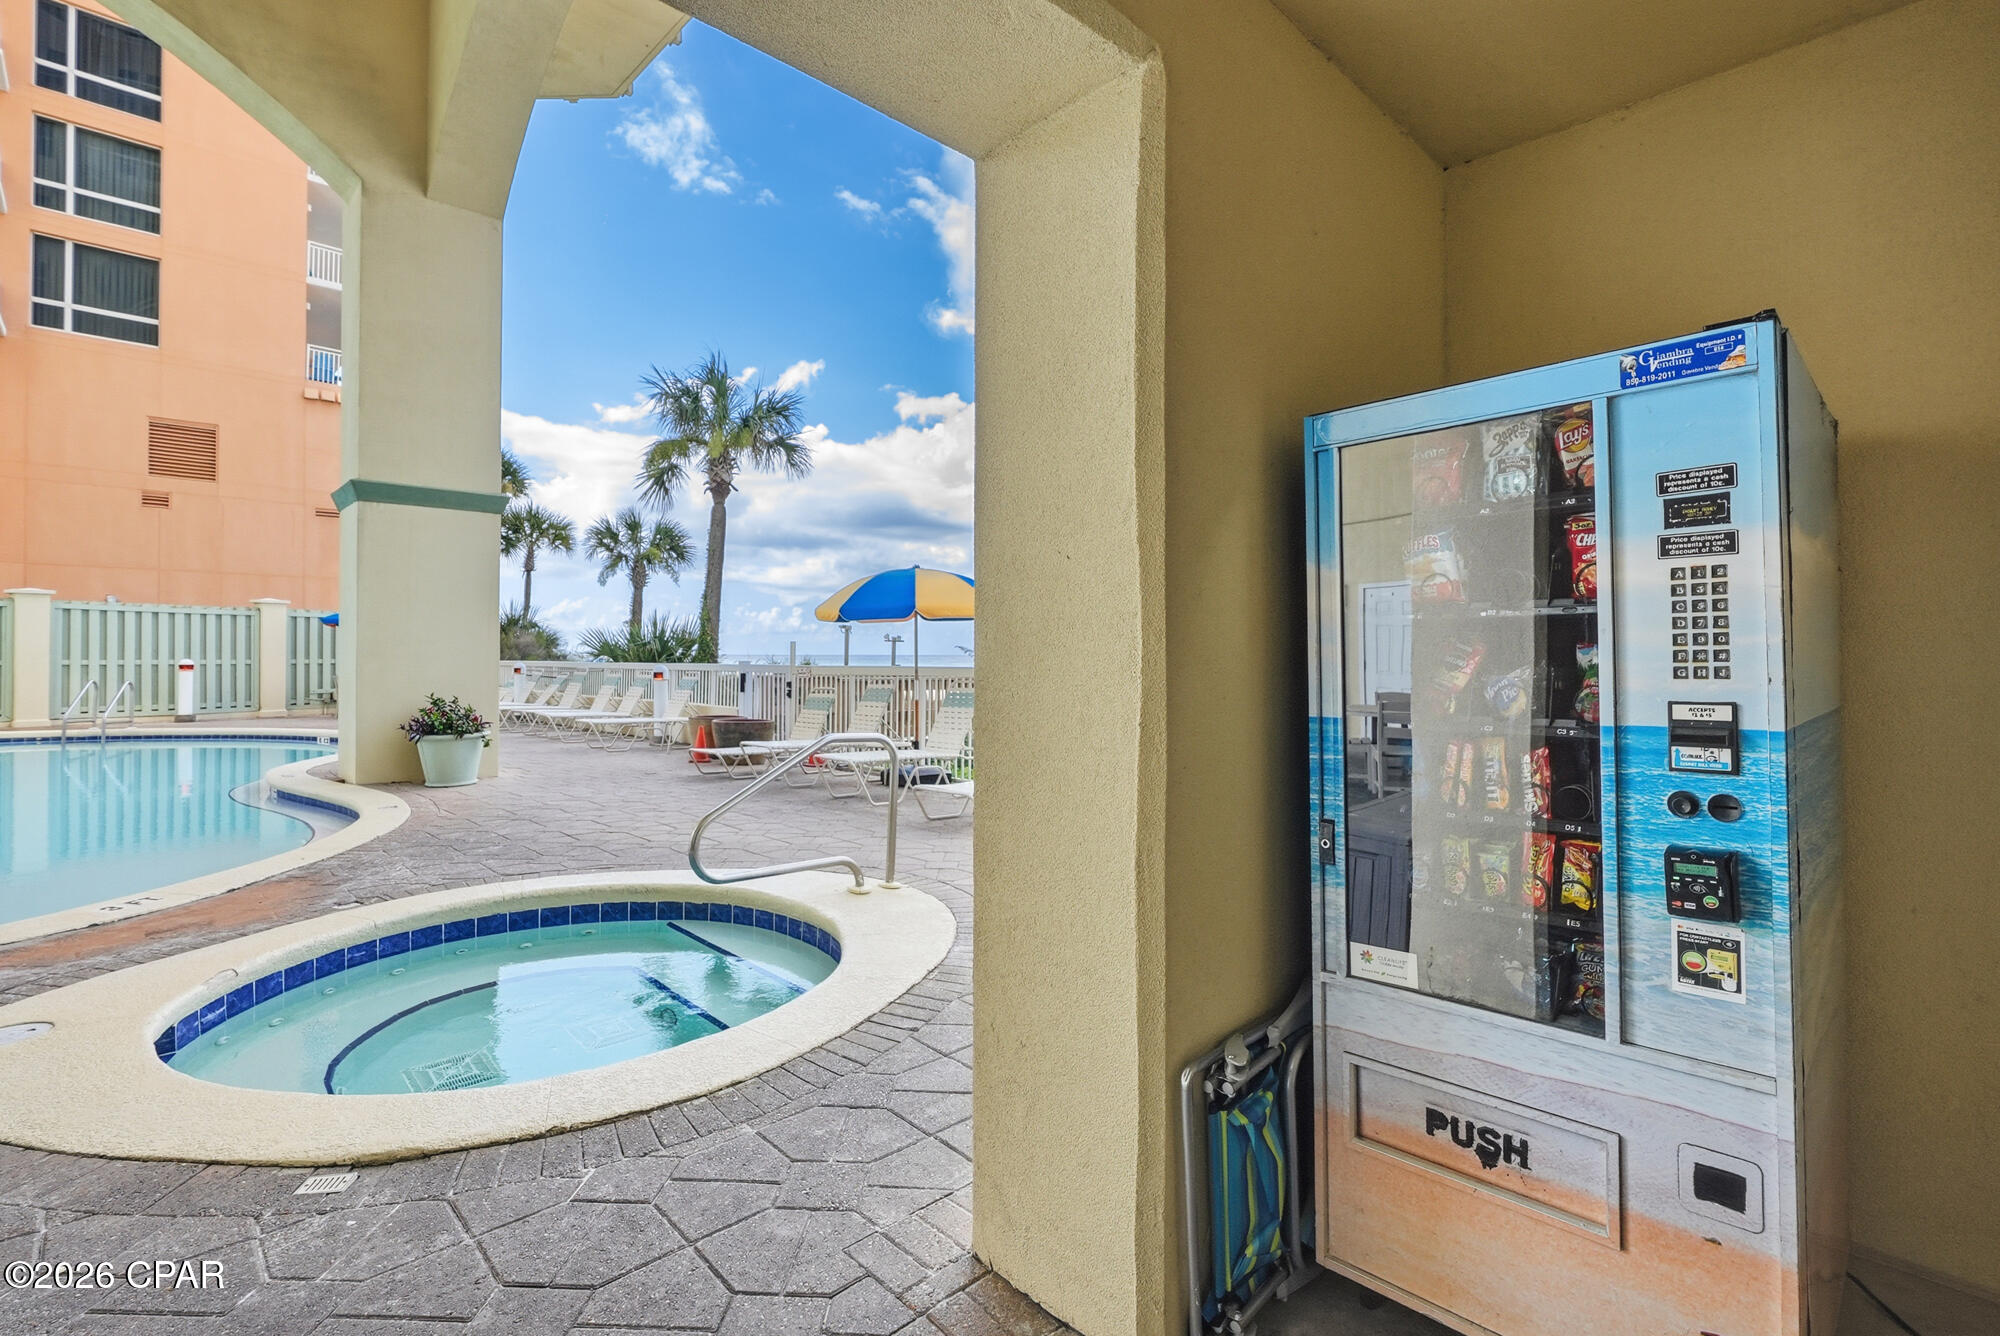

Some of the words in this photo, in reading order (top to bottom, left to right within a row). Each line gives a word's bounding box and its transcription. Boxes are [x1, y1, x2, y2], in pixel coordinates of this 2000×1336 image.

[1639, 348, 1693, 365] Giambra
[1648, 357, 1692, 372] Vending
[1626, 370, 1676, 386] 850-819-2011
[1558, 423, 1589, 449] Lay's
[1669, 472, 1687, 480] Price
[1689, 468, 1723, 478] displayed
[1664, 477, 1701, 487] represents
[1668, 484, 1698, 492] discount
[1671, 535, 1688, 543] Price
[1690, 533, 1724, 542] displayed
[1665, 541, 1703, 550] represents
[1669, 547, 1699, 555] discount
[1425, 1106, 1531, 1170] PUSH
